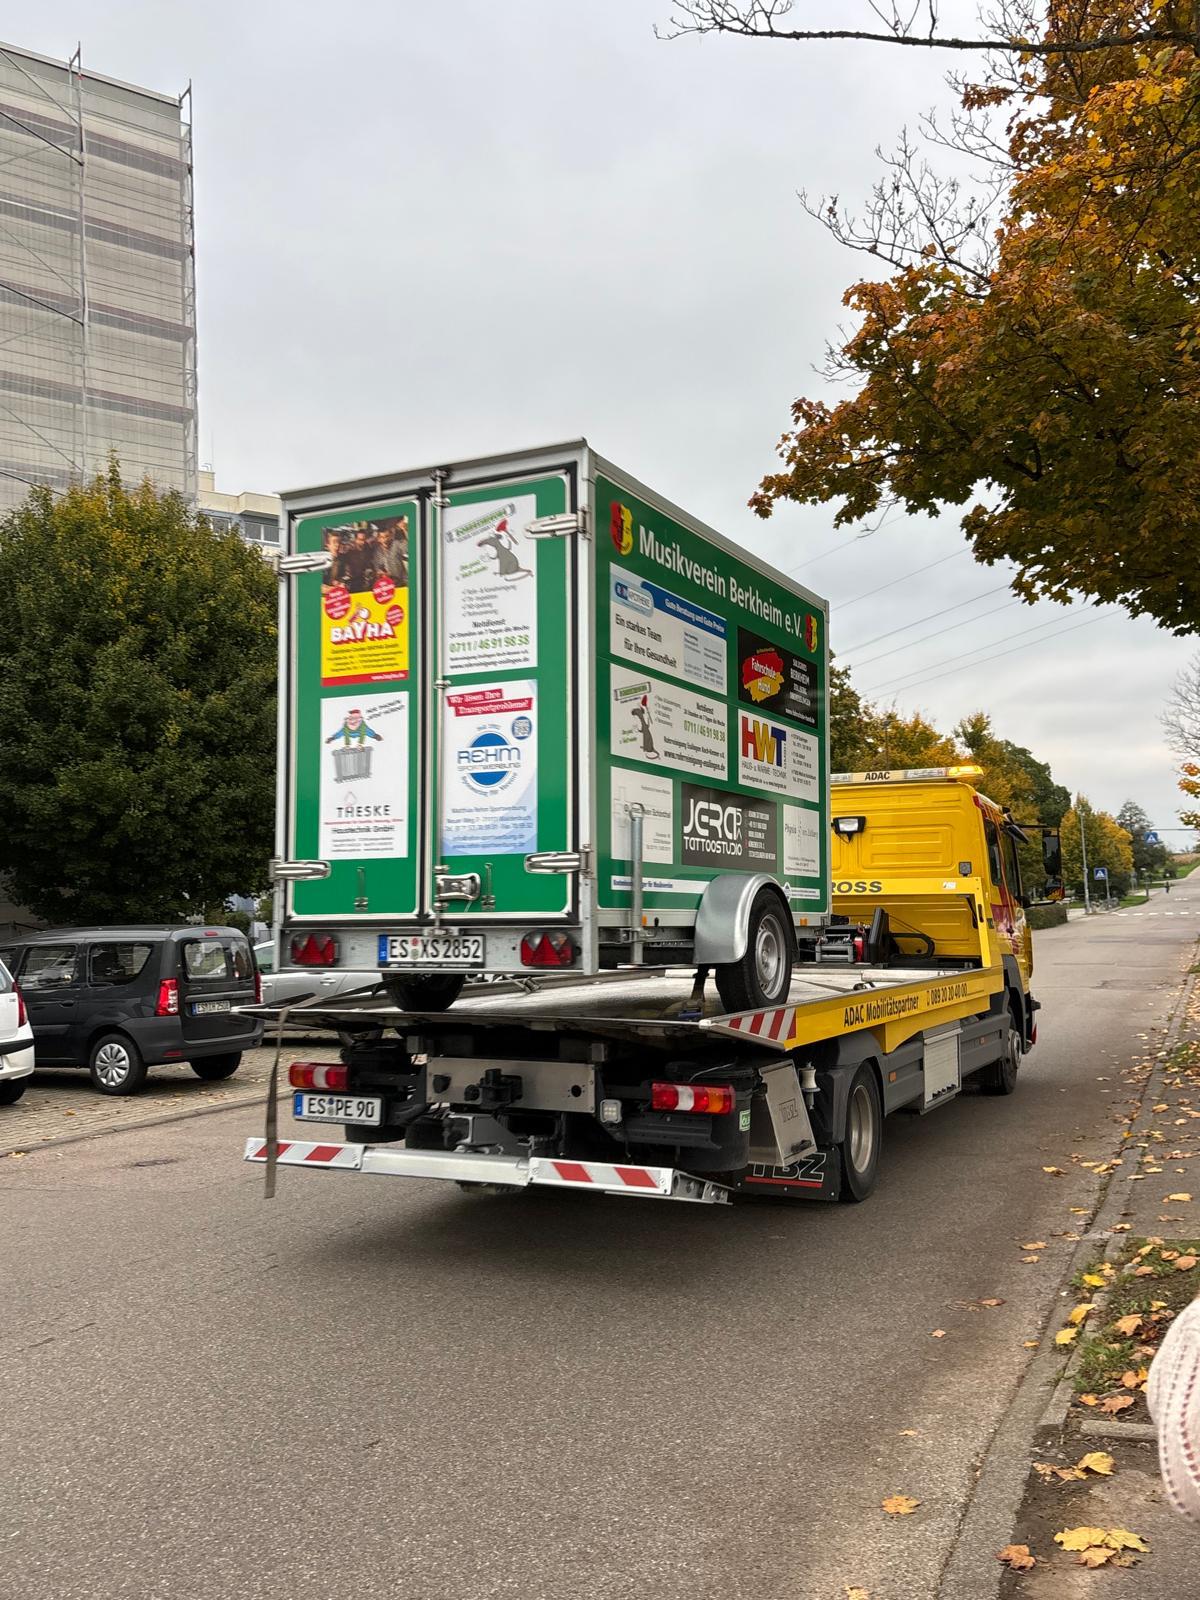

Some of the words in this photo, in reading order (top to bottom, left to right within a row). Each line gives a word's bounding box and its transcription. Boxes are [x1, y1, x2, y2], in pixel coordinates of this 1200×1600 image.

[639, 525, 726, 598] Musikverein
[730, 576, 782, 628] Berkheim
[784, 613, 802, 639] e.V.
[330, 621, 397, 645] BAYHA
[615, 613, 625, 627] Ein
[626, 621, 646, 636] starkes
[647, 626, 662, 642] Team
[449, 641, 472, 653] 0711
[624, 637, 633, 651] für
[634, 642, 645, 657] Ihre
[646, 648, 677, 669] Gesundheit
[752, 657, 776, 680] Fahrschule
[449, 695, 462, 704] Wir
[484, 691, 501, 700] Ihre
[459, 700, 529, 715] Transportprobleme!
[684, 720, 696, 734] 0711
[742, 716, 786, 767] HWT
[457, 747, 521, 765] REHM
[457, 763, 521, 771] SPORTWERBUNG
[865, 772, 890, 781] ADAC
[336, 805, 391, 818] THESKE
[683, 836, 742, 856] TATTOOSTUDIO
[390, 939, 409, 958] ES
[421, 939, 440, 958] XS
[443, 939, 481, 958] 2852
[844, 1005, 865, 1028] ADAC
[866, 995, 919, 1021] Mobilitätspartner
[931, 988, 941, 1003] 089
[942, 986, 948, 1002] 20
[948, 985, 954, 1001] 20
[308, 1097, 326, 1114] ES
[335, 1099, 353, 1117] PE
[357, 1100, 375, 1118] 90
